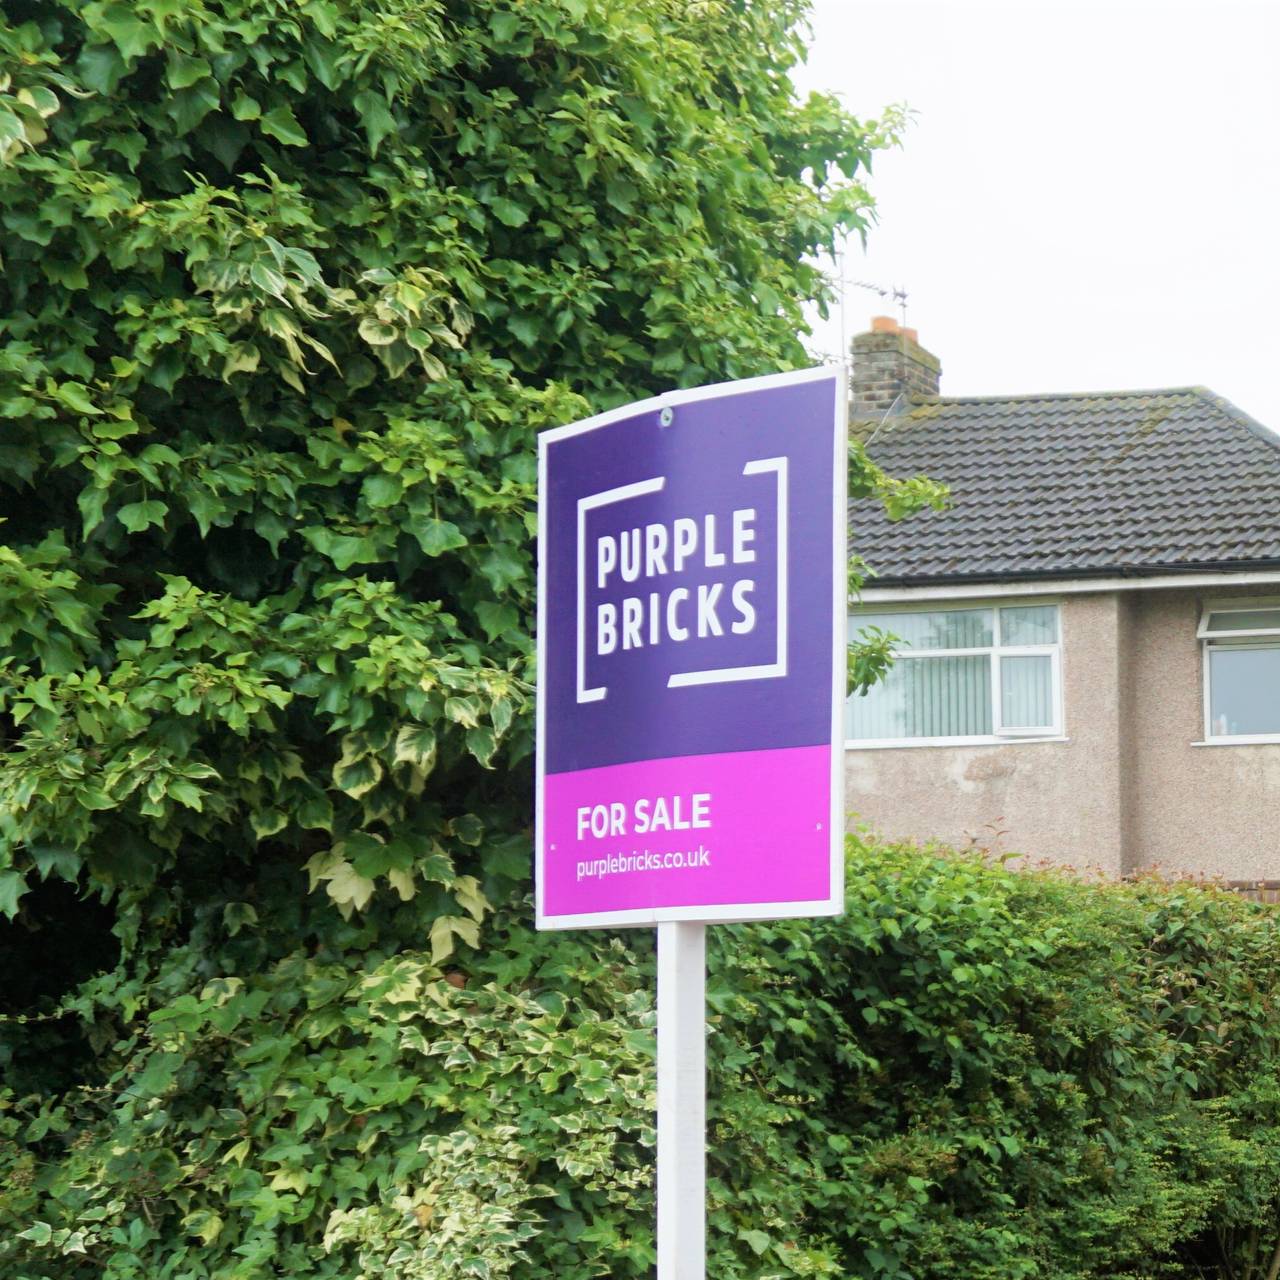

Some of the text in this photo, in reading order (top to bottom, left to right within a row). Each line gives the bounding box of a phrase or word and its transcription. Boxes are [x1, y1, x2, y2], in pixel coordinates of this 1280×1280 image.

[597, 508, 756, 588] PURPLE
[597, 579, 756, 655] BRICKS
[577, 793, 711, 840] FOR SALE
[577, 846, 710, 881] purplebricks.co.uk
